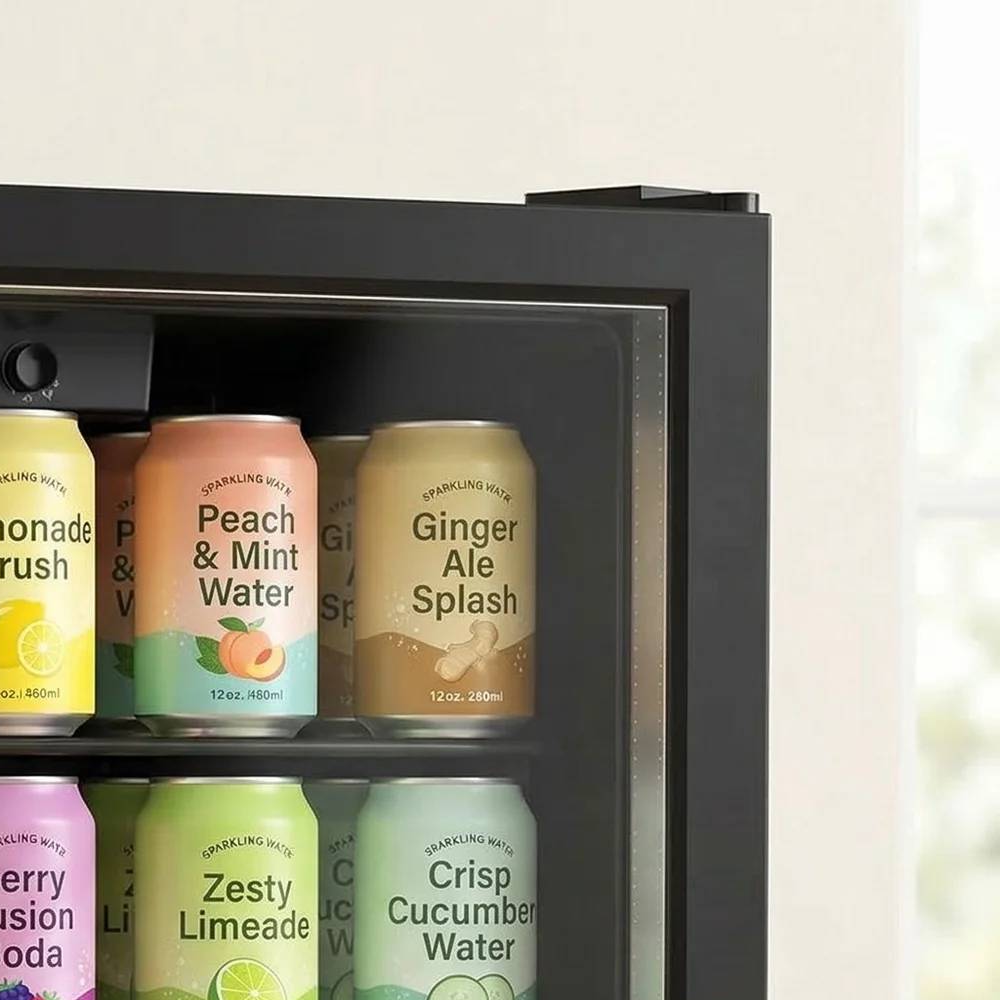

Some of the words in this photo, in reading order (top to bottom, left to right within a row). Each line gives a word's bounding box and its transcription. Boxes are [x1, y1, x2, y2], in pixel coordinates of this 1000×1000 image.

[201, 473, 264, 497] SPARKLING
[422, 479, 483, 503] SPARKLING
[198, 503, 296, 534] Peach
[412, 512, 519, 548] Ginger
[193, 540, 219, 570] &
[231, 540, 298, 571] Mint
[441, 549, 494, 578] Ale
[198, 577, 294, 607] Water
[412, 584, 518, 620] Splash
[201, 835, 264, 860] SPARKLING
[203, 872, 293, 909] Zesty
[428, 859, 511, 896] Crisp
[179, 910, 309, 940] Limeade
[387, 896, 536, 925] Cucumber
[423, 932, 515, 961] Water
